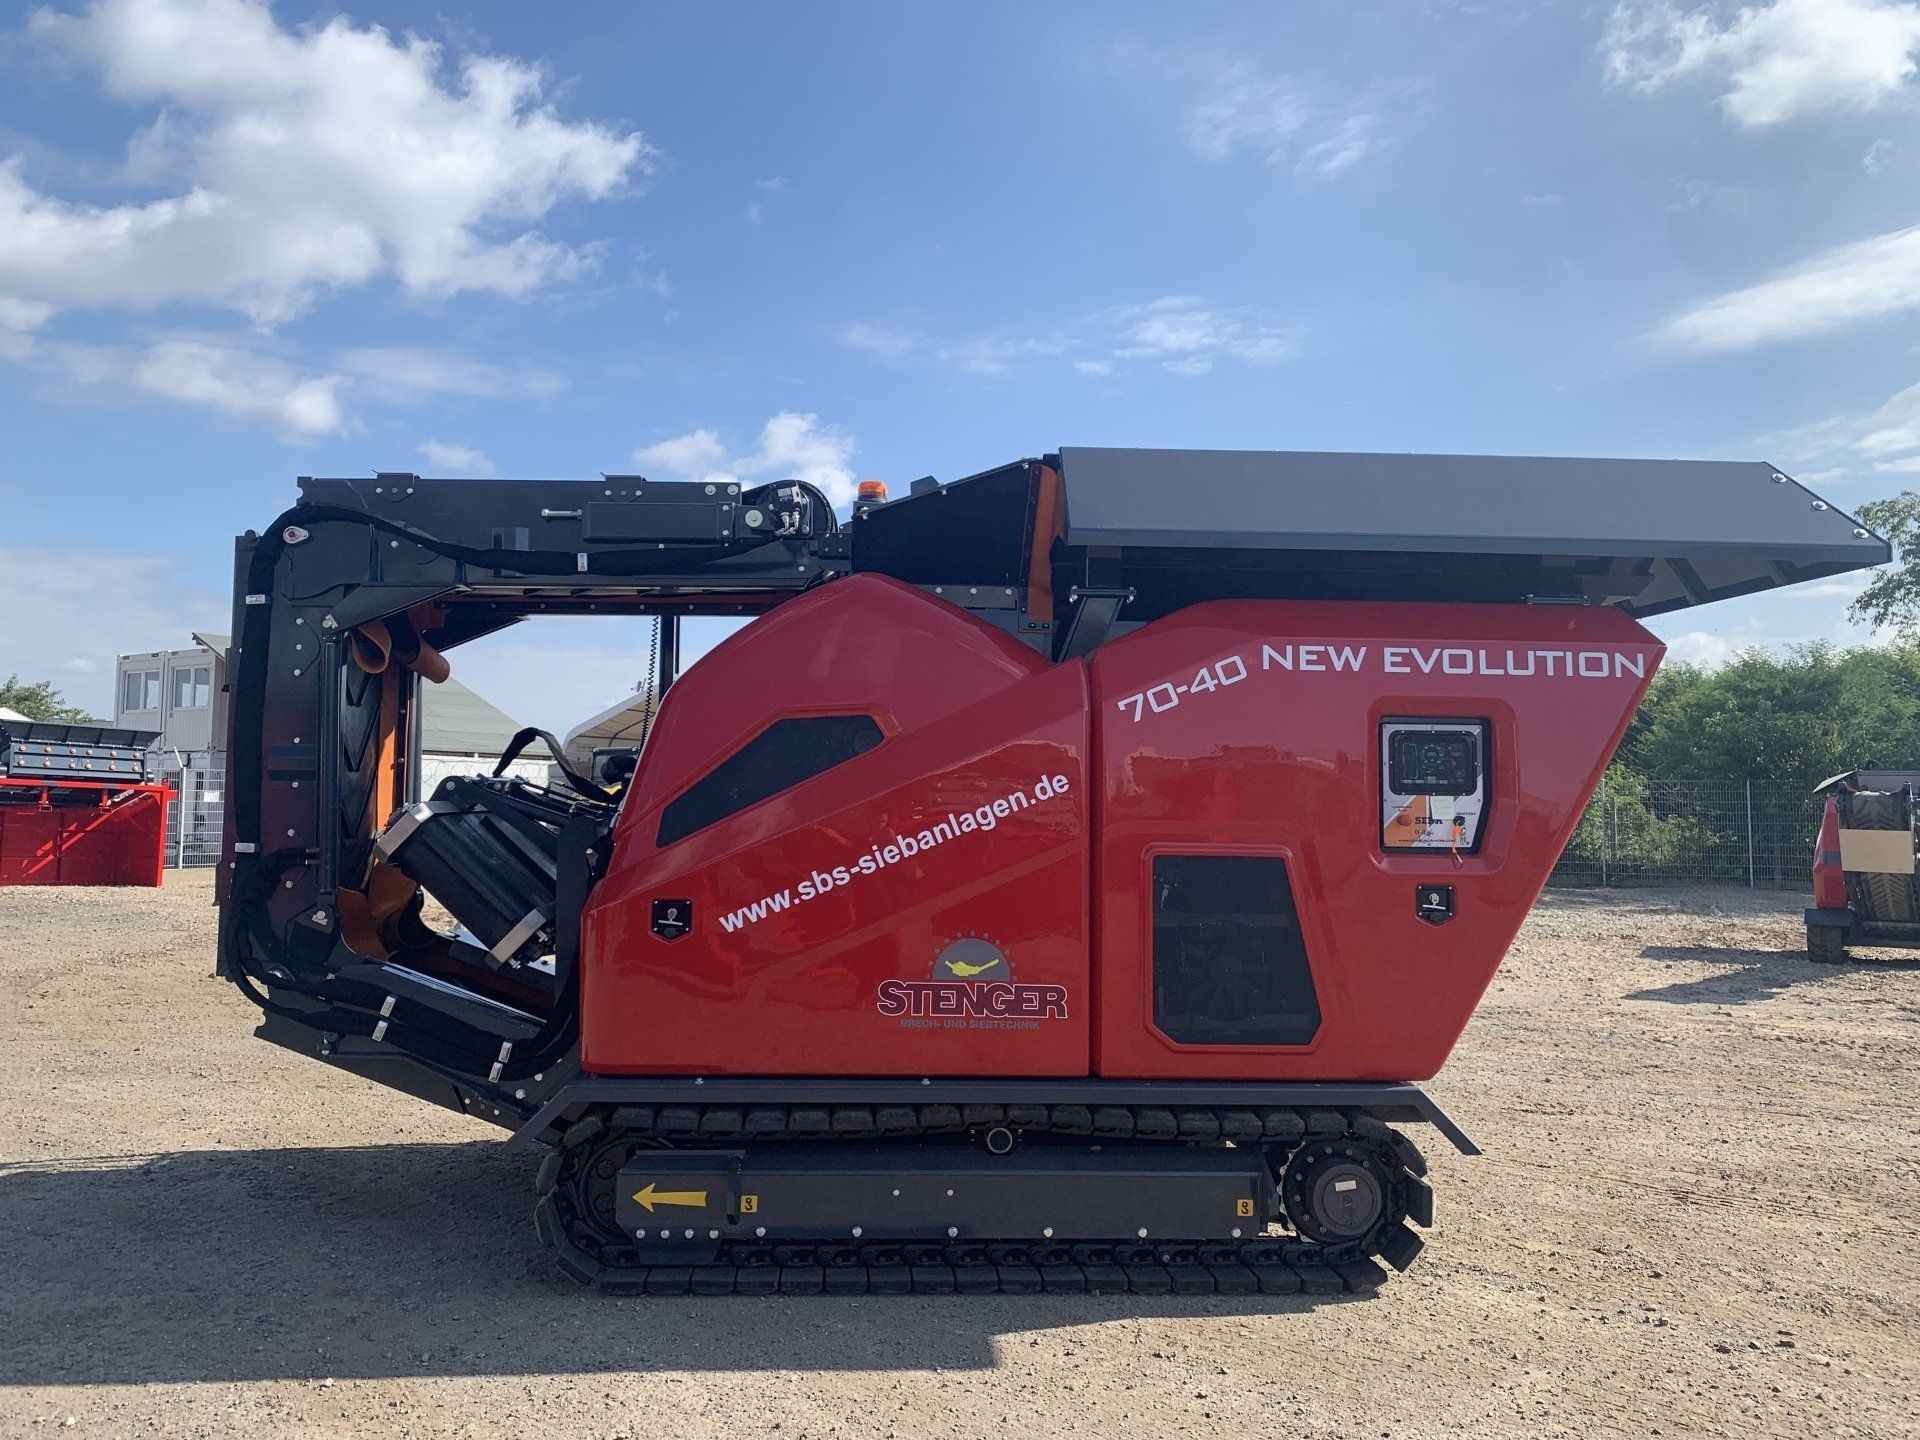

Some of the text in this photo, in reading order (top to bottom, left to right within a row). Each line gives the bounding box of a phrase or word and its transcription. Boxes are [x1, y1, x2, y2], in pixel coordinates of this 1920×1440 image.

[1117, 644, 1645, 723] 70-40 NEW EVOLUTION
[718, 772, 1070, 933] www.sbs-siebanlagen.de
[877, 979, 1068, 1019] STENGER
[900, 1019, 1040, 1030] BRECH- UND SIEBTECHNIK
